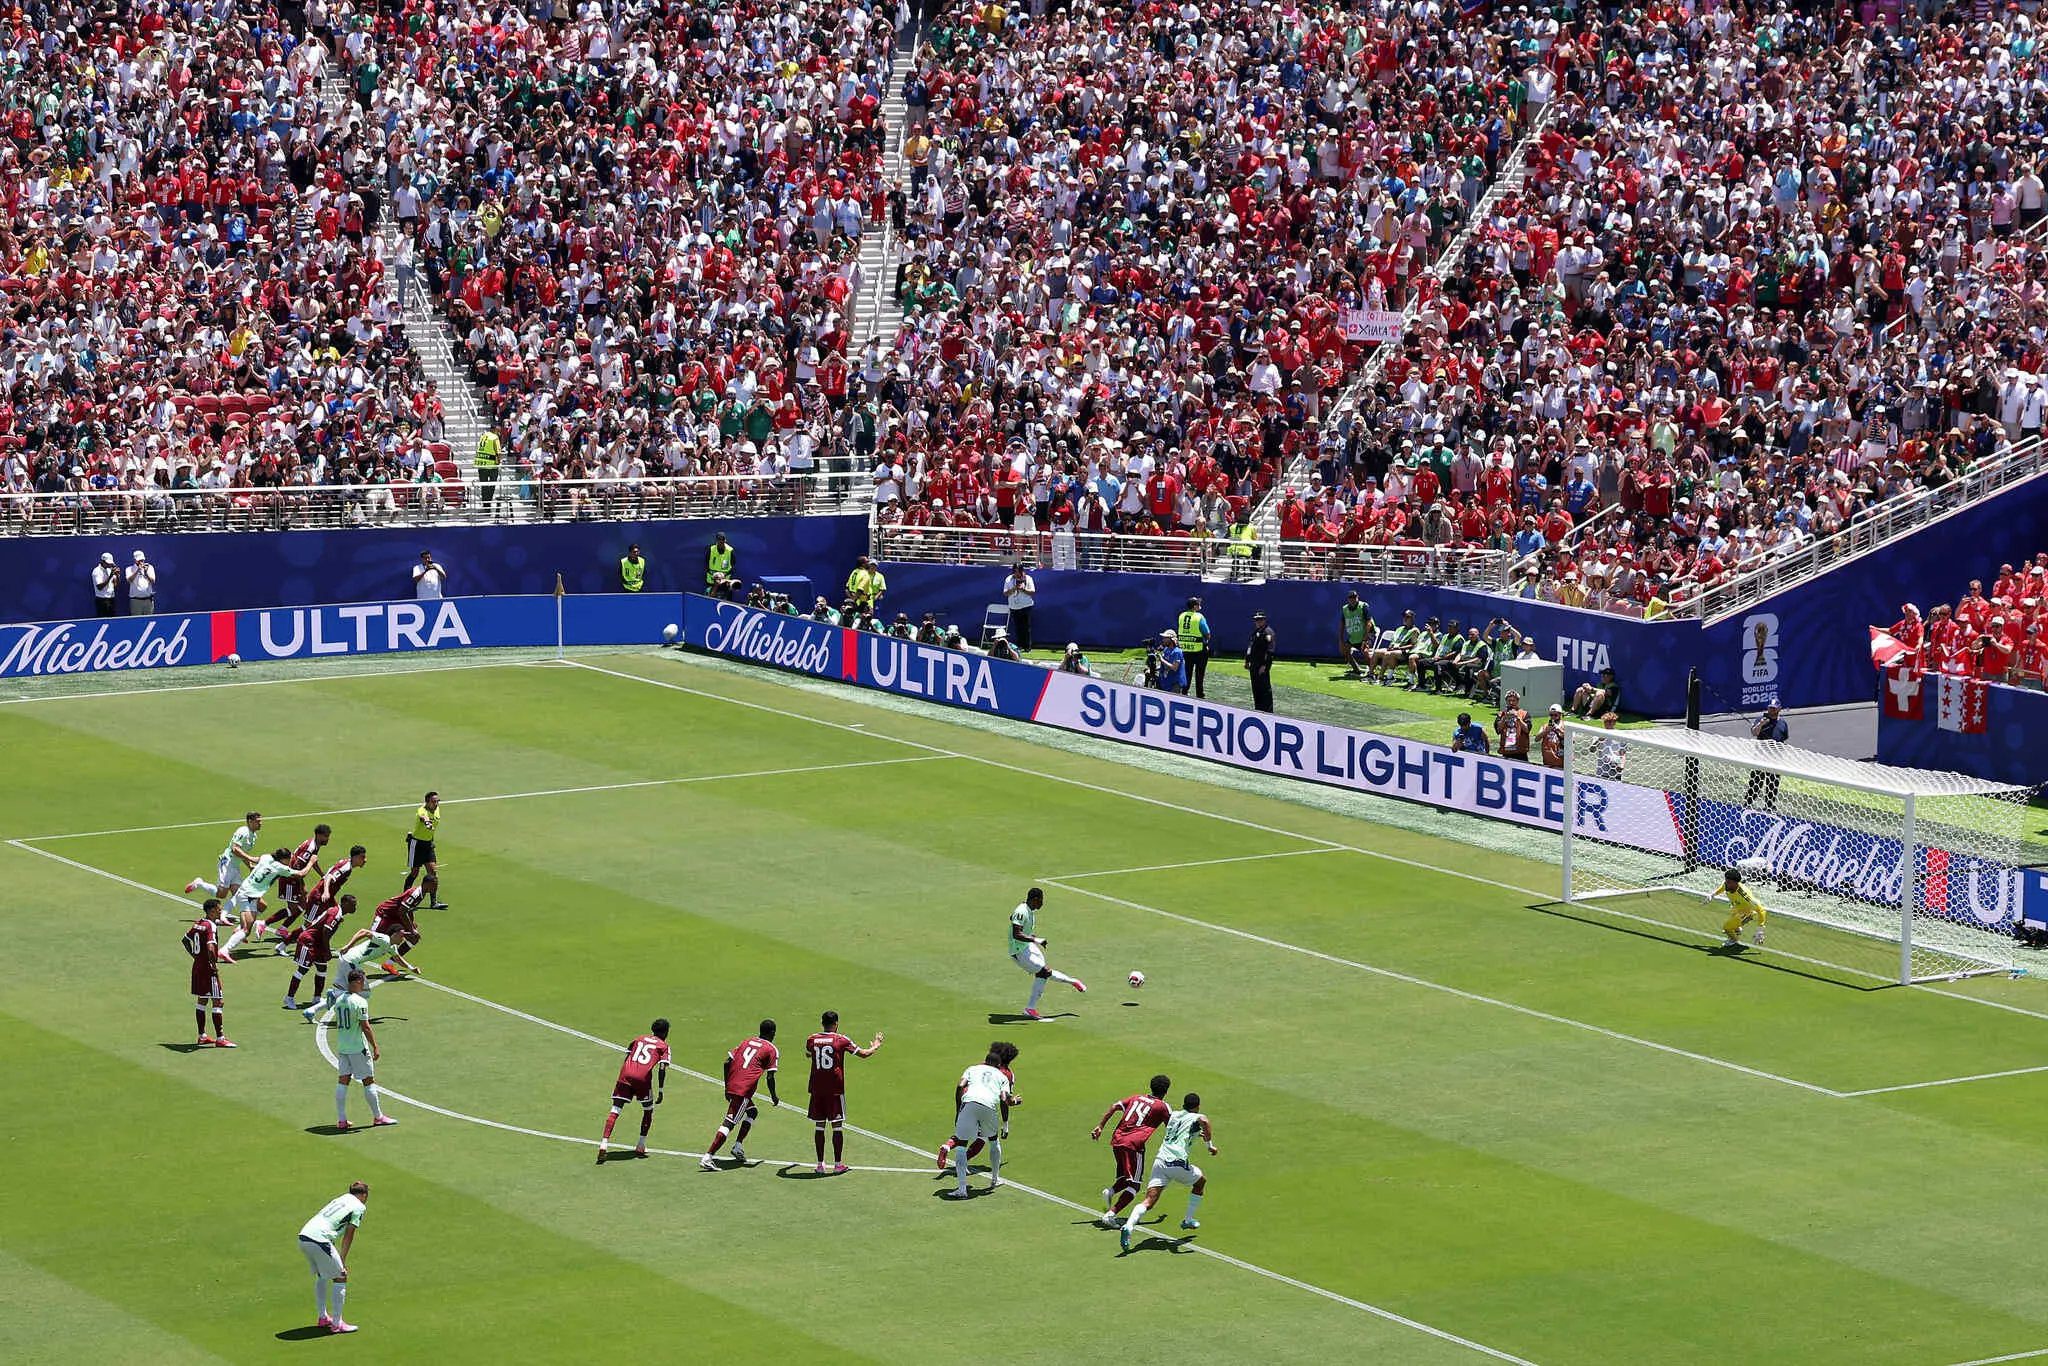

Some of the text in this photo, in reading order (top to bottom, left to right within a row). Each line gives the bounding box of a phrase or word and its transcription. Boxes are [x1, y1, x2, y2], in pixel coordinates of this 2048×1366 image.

[993, 536, 1011, 547] 123
[1407, 554, 1425, 565] 124
[0, 601, 472, 675] Michelob ULTRA
[705, 602, 999, 709] Michelob ULTRA
[1556, 635, 1611, 674] FIFA
[1752, 668, 1769, 678] FIFA
[1741, 692, 1779, 705] 2026
[1742, 683, 1779, 694] WORLD CUP
[1080, 684, 1609, 832] SUPERIOR LIGHT BEER
[1725, 810, 2048, 930] Michelob UL
[193, 932, 201, 955] 8
[337, 1006, 351, 1030] 10
[631, 1041, 657, 1065] 15
[742, 1046, 757, 1069] 4
[813, 1045, 834, 1070] 16
[1124, 1100, 1151, 1127] 14
